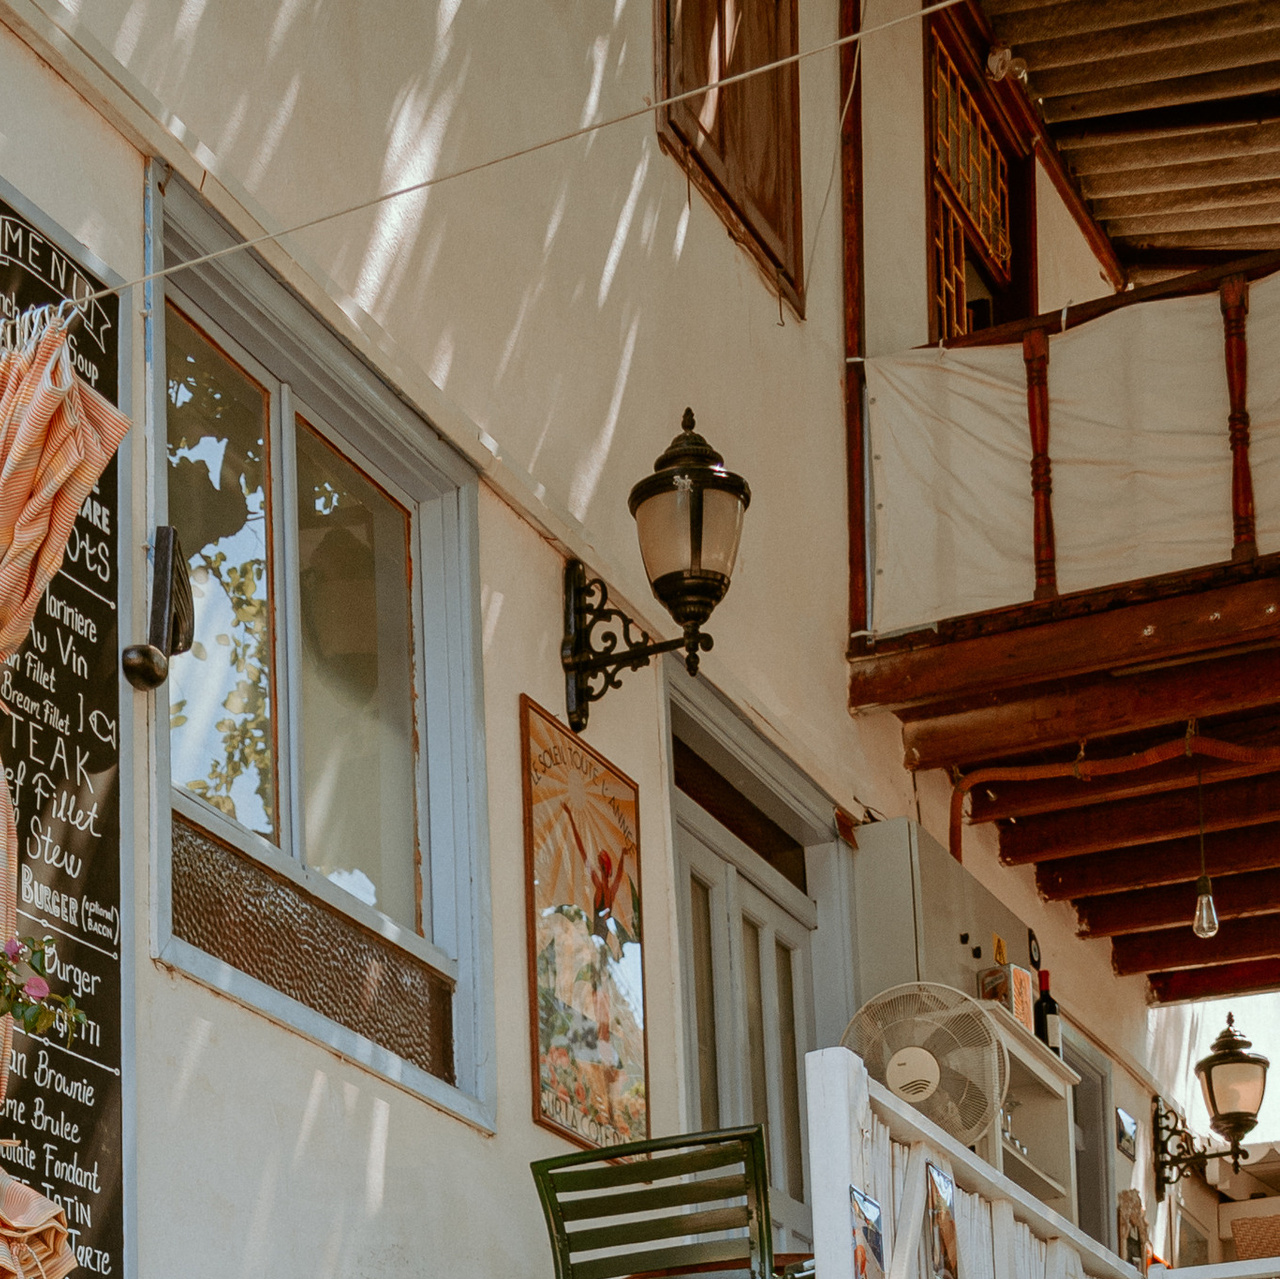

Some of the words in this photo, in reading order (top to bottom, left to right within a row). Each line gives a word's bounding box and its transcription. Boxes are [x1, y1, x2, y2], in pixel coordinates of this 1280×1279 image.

[4, 220, 90, 313] MENU
[67, 334, 99, 387] Soup
[78, 496, 111, 536] ARE
[25, 651, 56, 693] Fillet
[56, 627, 88, 679] Vin
[1, 670, 41, 720] Bream
[43, 699, 70, 736] Fillet
[32, 772, 102, 837] Fillet
[26, 815, 82, 879] Stew
[21, 863, 79, 927] BURGER
[43, 935, 102, 998] Burger
[34, 1050, 95, 1107] Brownie
[31, 1097, 81, 1144] Brulee
[43, 1143, 101, 1194] Fondant
